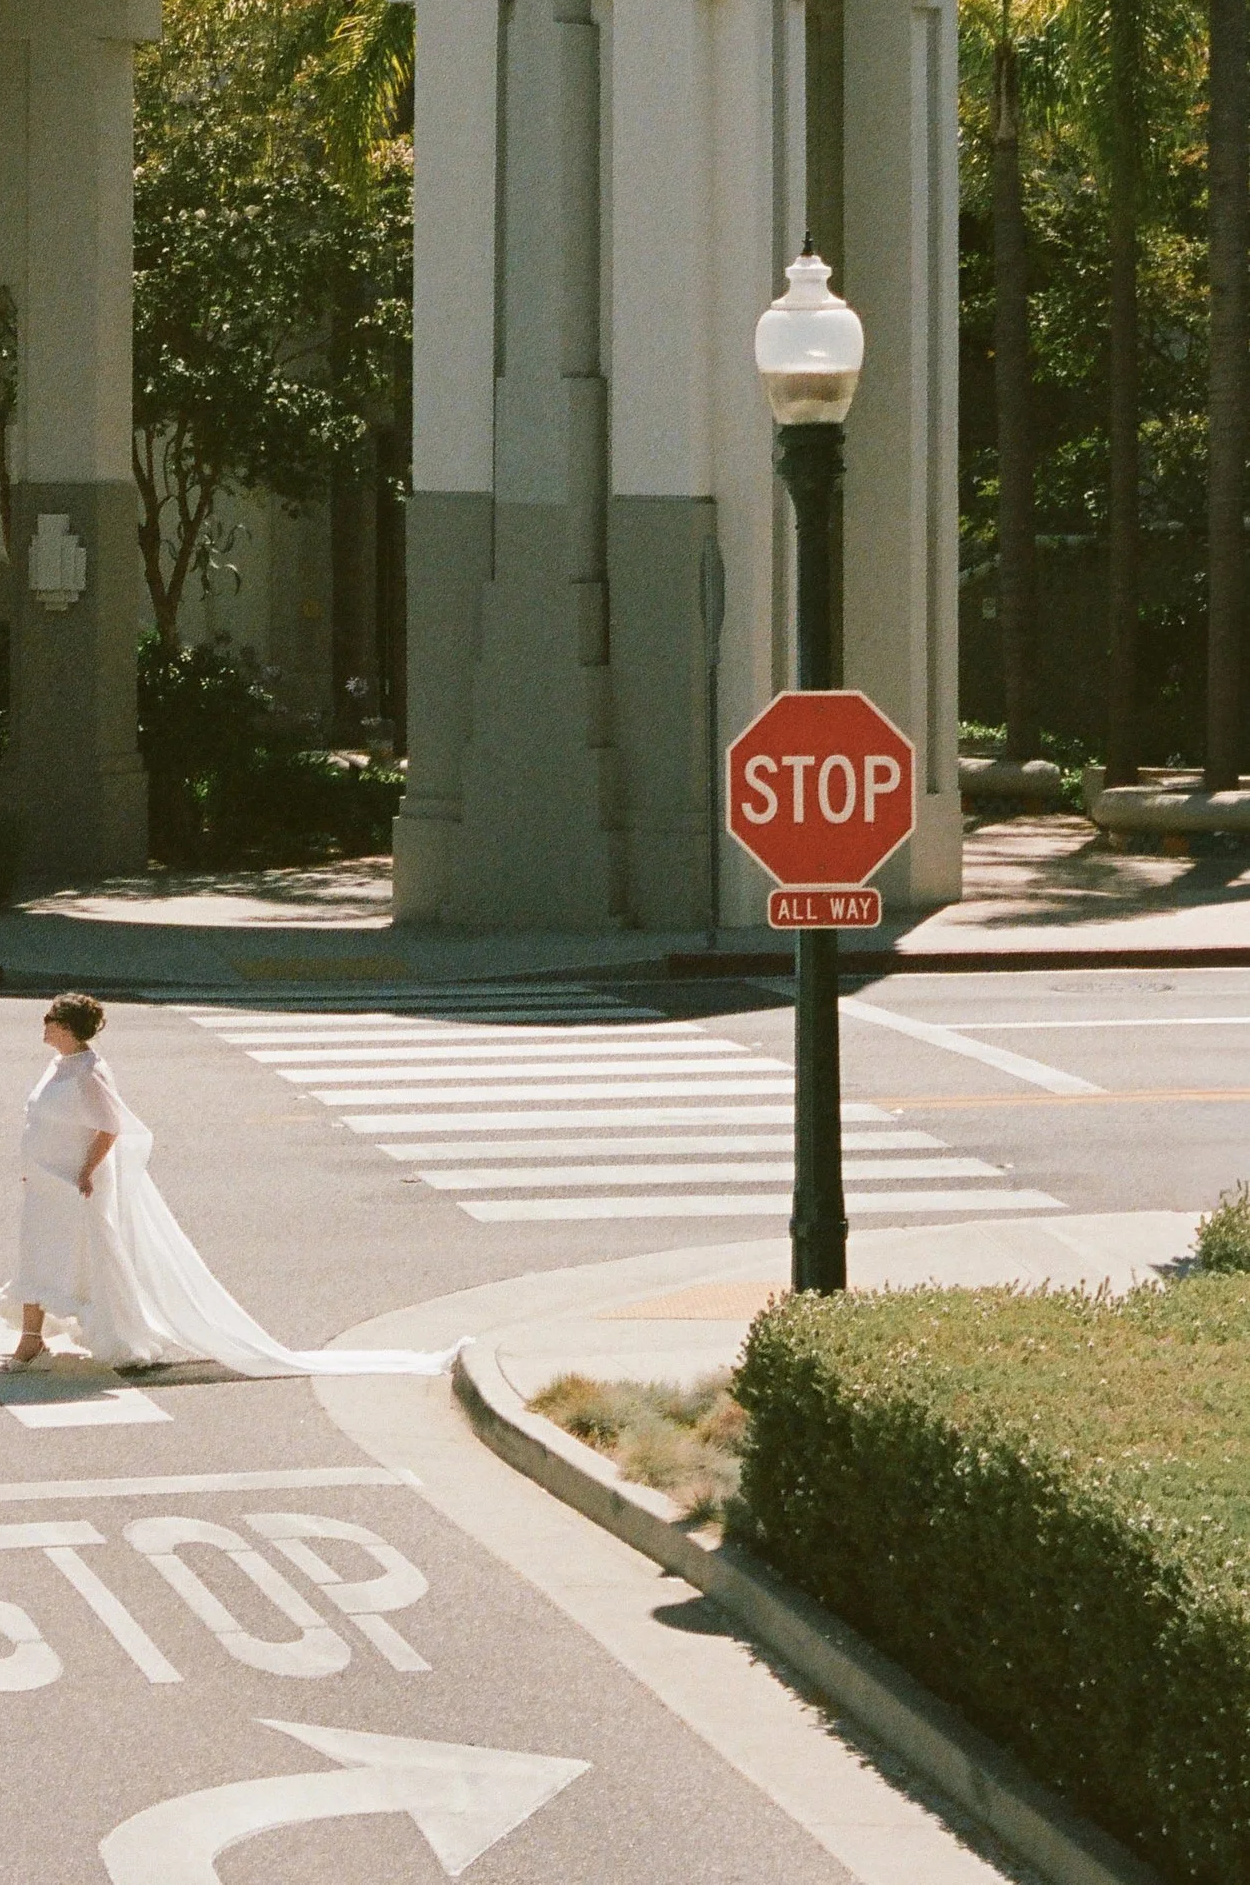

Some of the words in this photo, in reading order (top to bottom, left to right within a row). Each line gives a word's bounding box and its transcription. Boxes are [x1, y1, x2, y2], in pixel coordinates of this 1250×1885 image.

[741, 755, 901, 824] STOP
[777, 898, 818, 921] ALL
[830, 898, 872, 921] WAY
